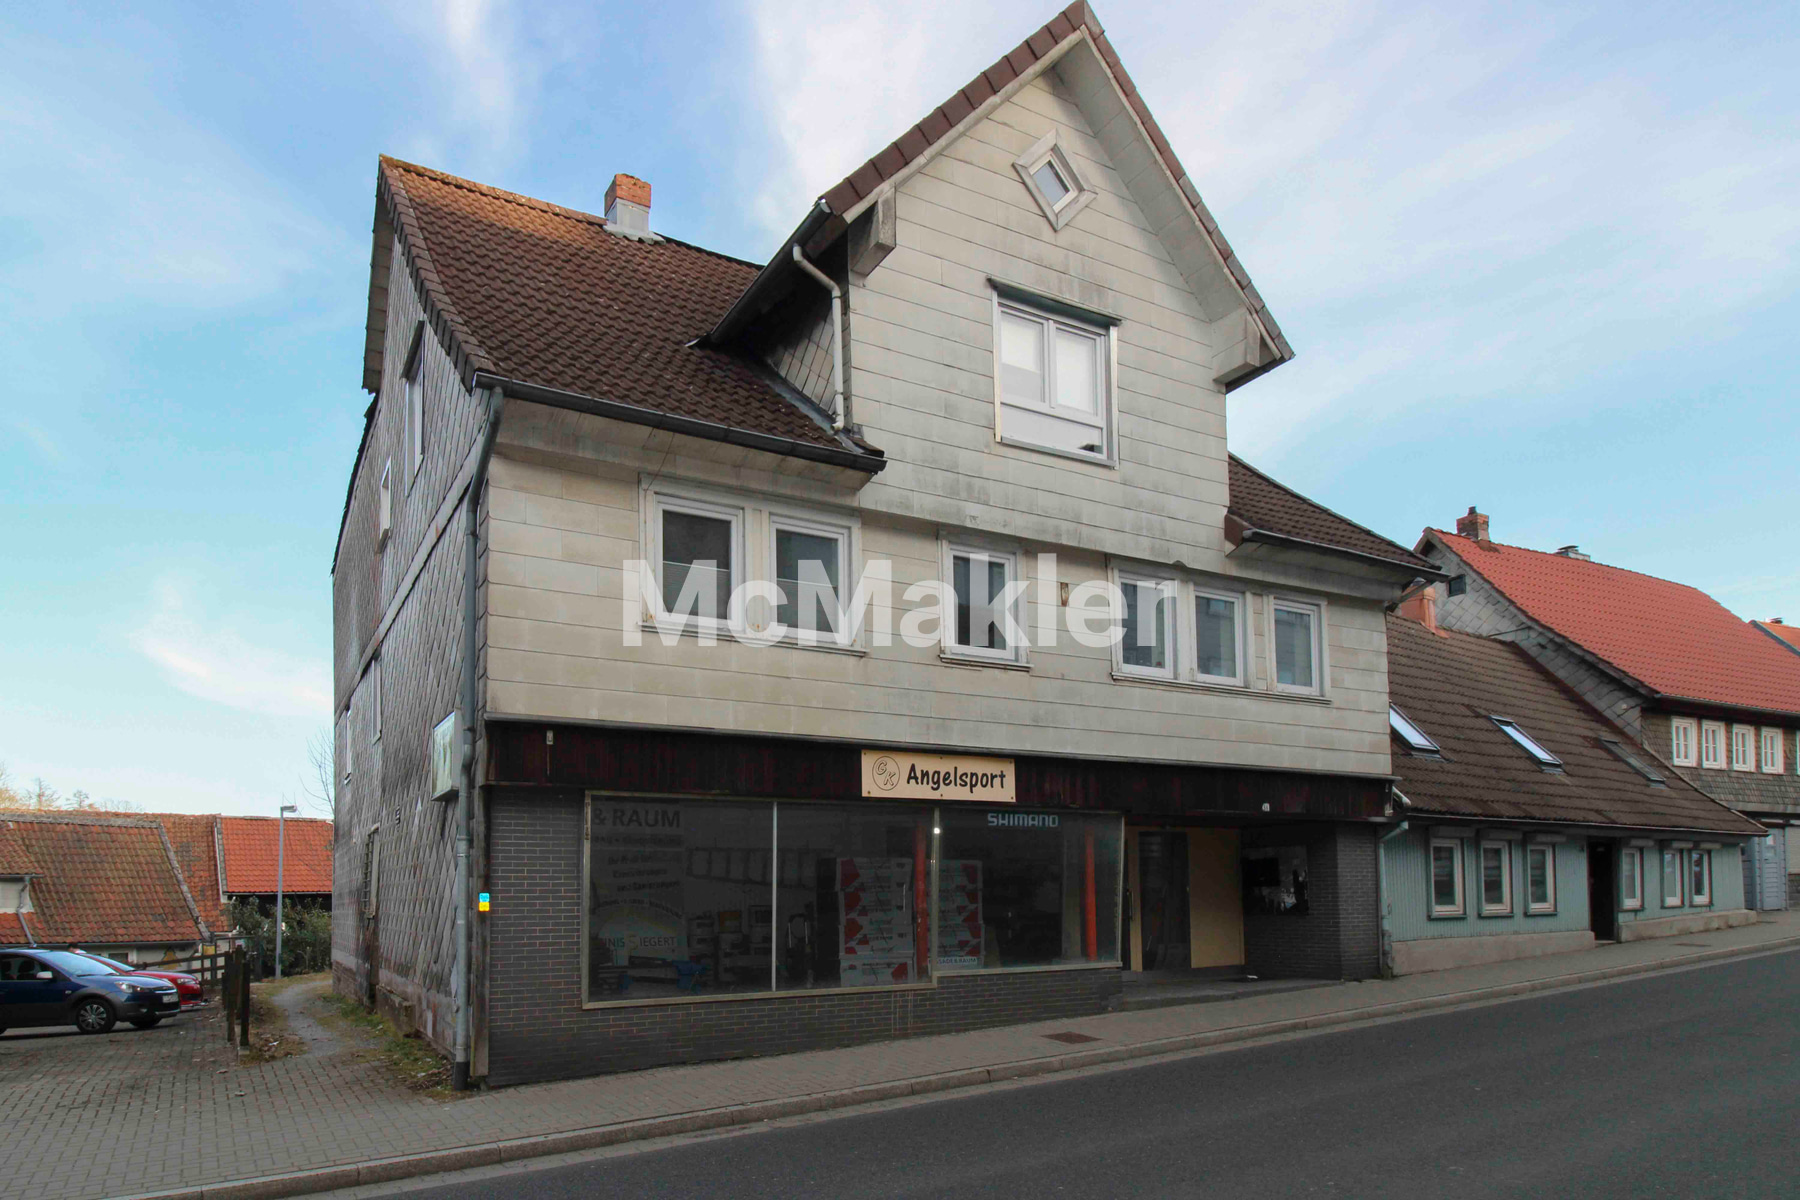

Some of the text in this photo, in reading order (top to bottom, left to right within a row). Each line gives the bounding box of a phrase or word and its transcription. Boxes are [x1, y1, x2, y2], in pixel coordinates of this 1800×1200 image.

[906, 763, 1006, 793] Angelsport
[612, 808, 681, 829] RAUM
[987, 812, 1059, 828] SHIMANO
